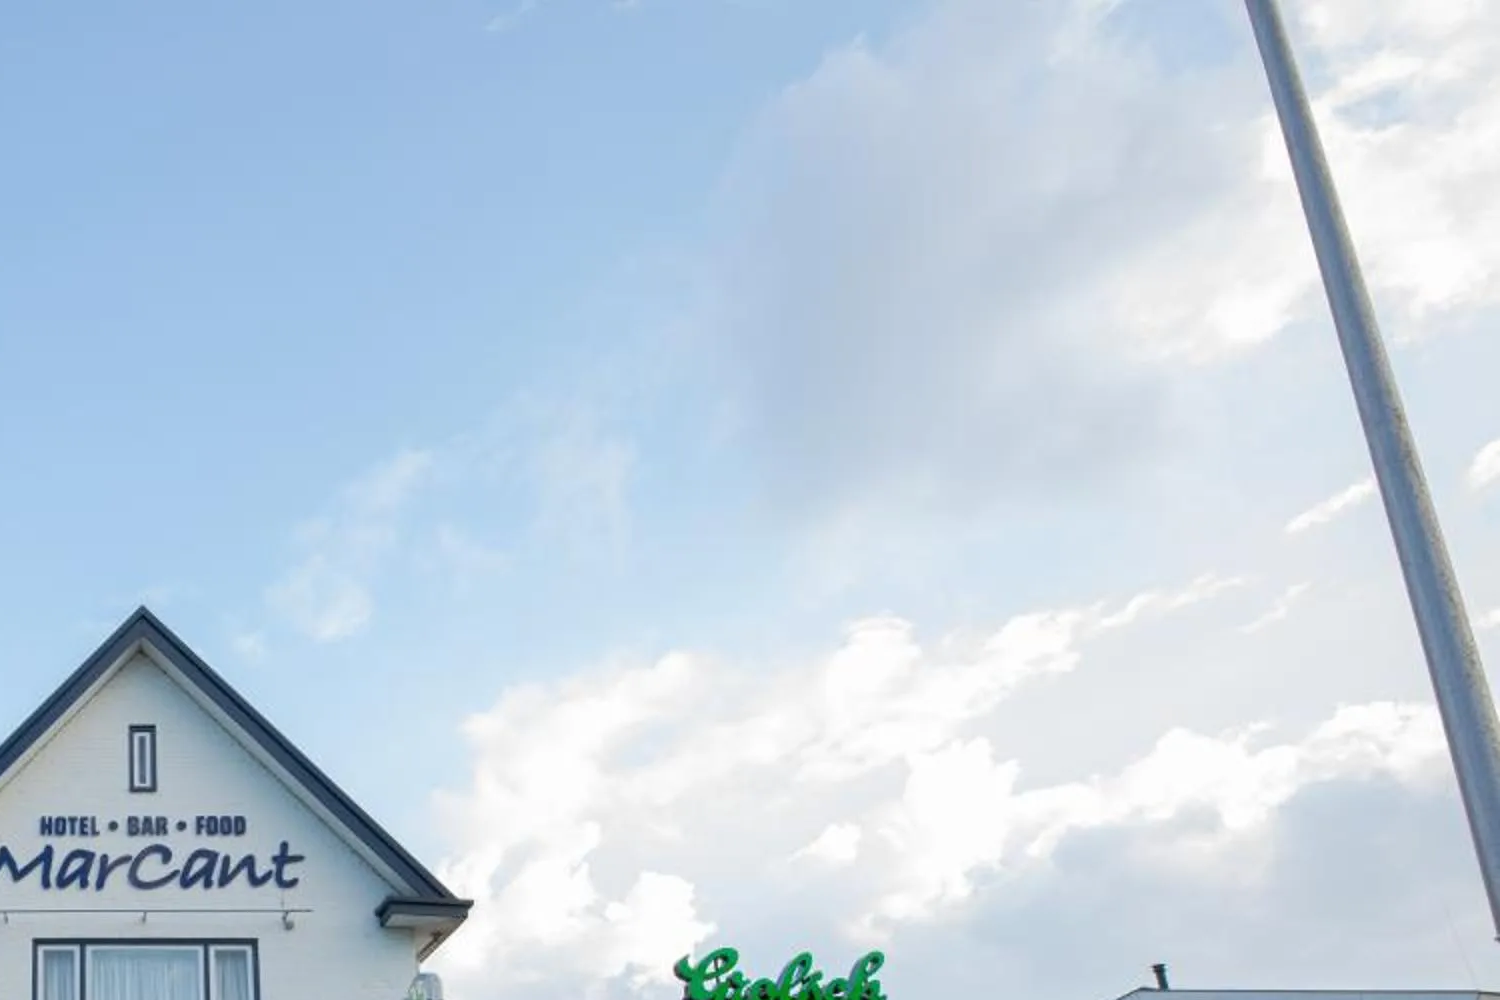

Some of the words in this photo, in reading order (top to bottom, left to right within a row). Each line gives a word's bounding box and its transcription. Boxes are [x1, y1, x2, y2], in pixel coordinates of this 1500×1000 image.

[39, 815, 100, 837] HOTEL
[126, 815, 168, 836] BAR
[195, 815, 247, 836] FOOD
